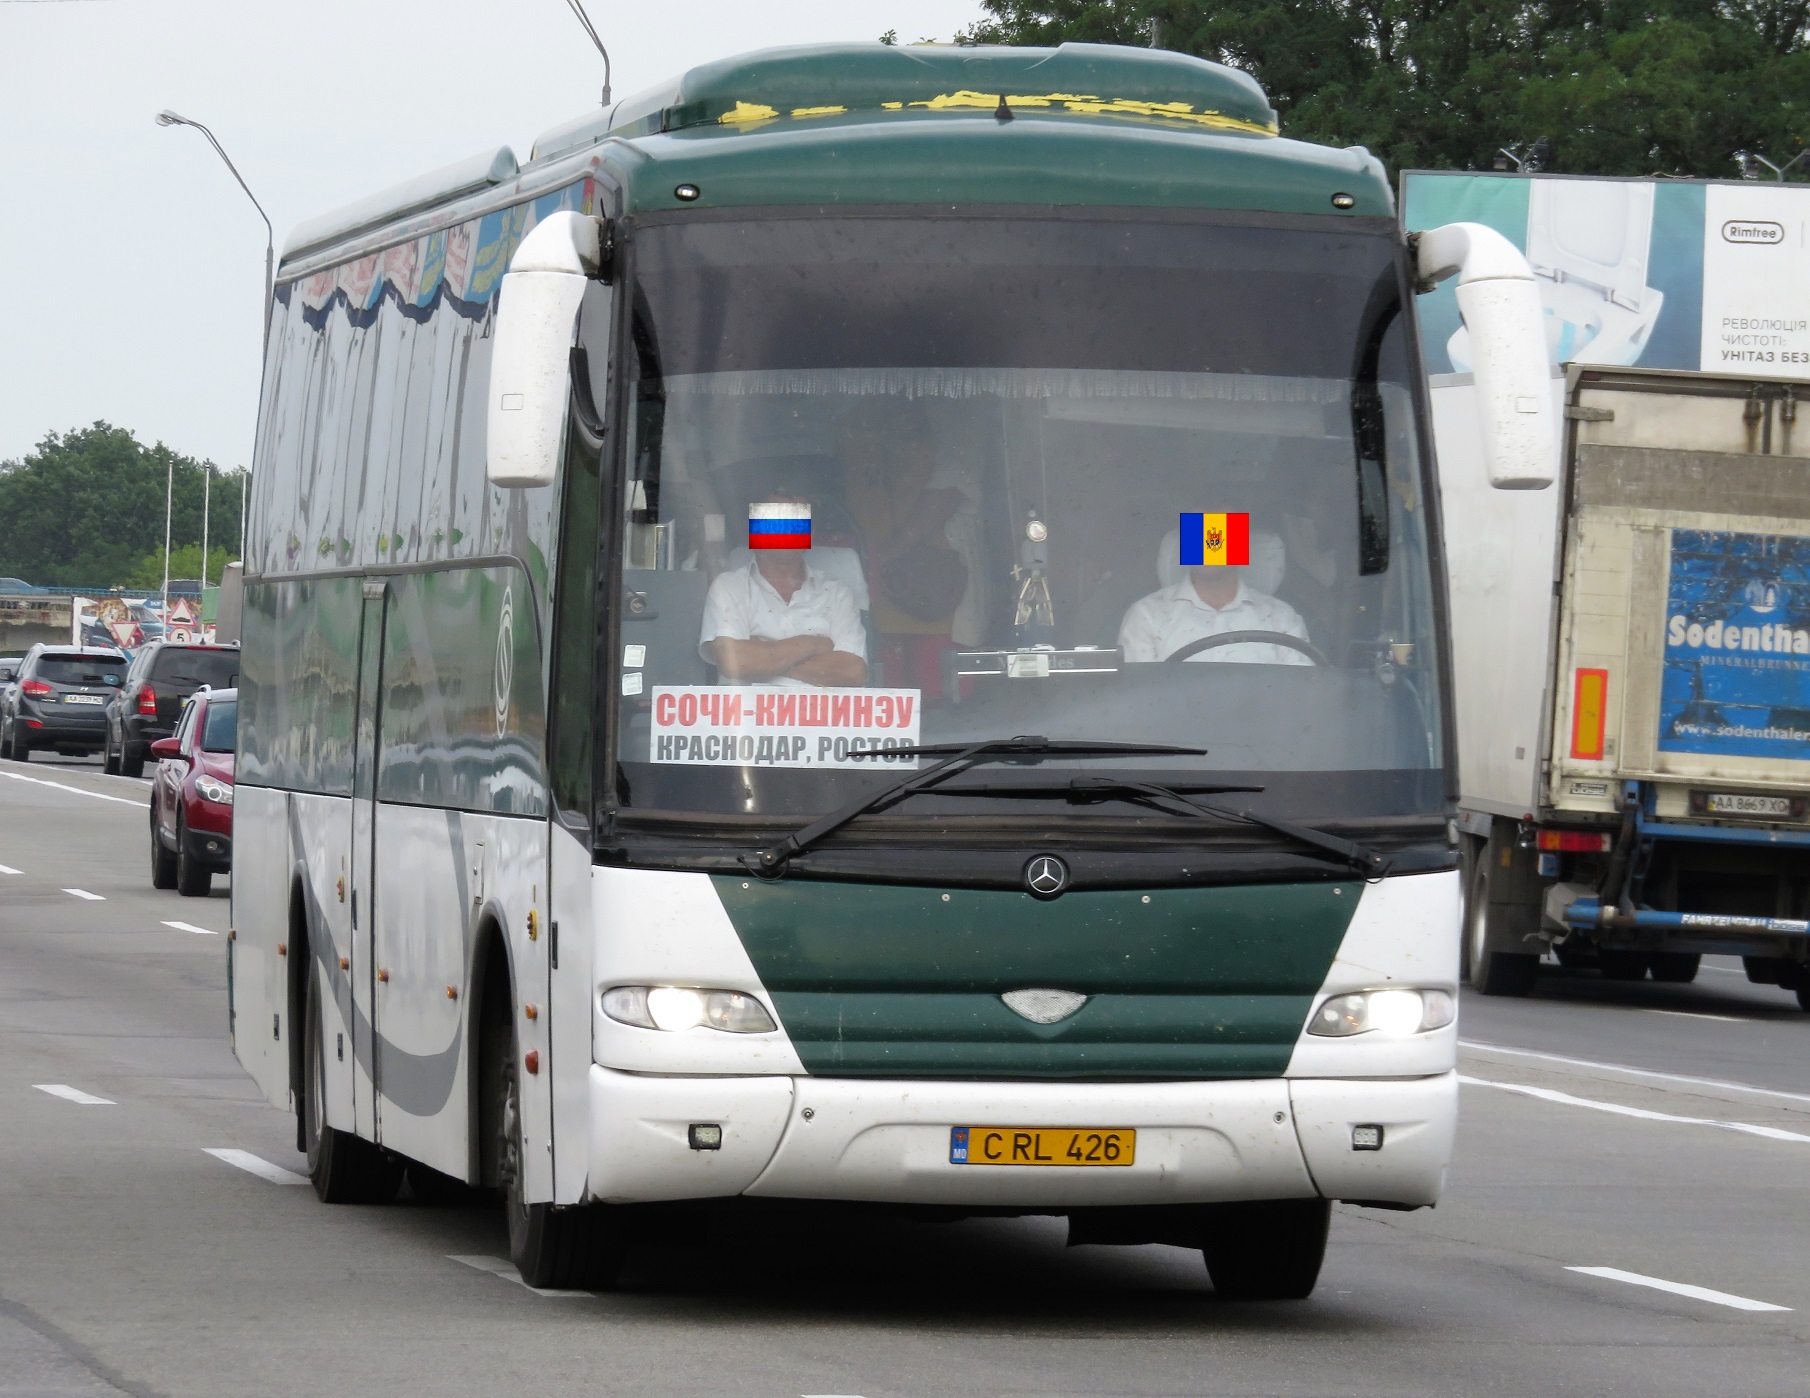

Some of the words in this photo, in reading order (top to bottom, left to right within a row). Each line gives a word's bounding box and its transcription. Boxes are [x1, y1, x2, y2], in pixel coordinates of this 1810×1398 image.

[1730, 226, 1777, 239] Rimfree
[1722, 317, 1807, 332] РЕВОЛЮЦІЯ
[1721, 350, 1775, 362] УНІТАЗ
[1781, 352, 1809, 363] БЕЗ
[177, 632, 184, 642] 5
[1668, 615, 1810, 654] Sodentha
[656, 693, 914, 728] СОЧИ-КИШИНЭУ
[657, 734, 811, 764] КРАСНОДАР,
[818, 736, 915, 763] РОСТОВ
[953, 1149, 967, 1159] MD
[1067, 1134, 1120, 1161] 426
